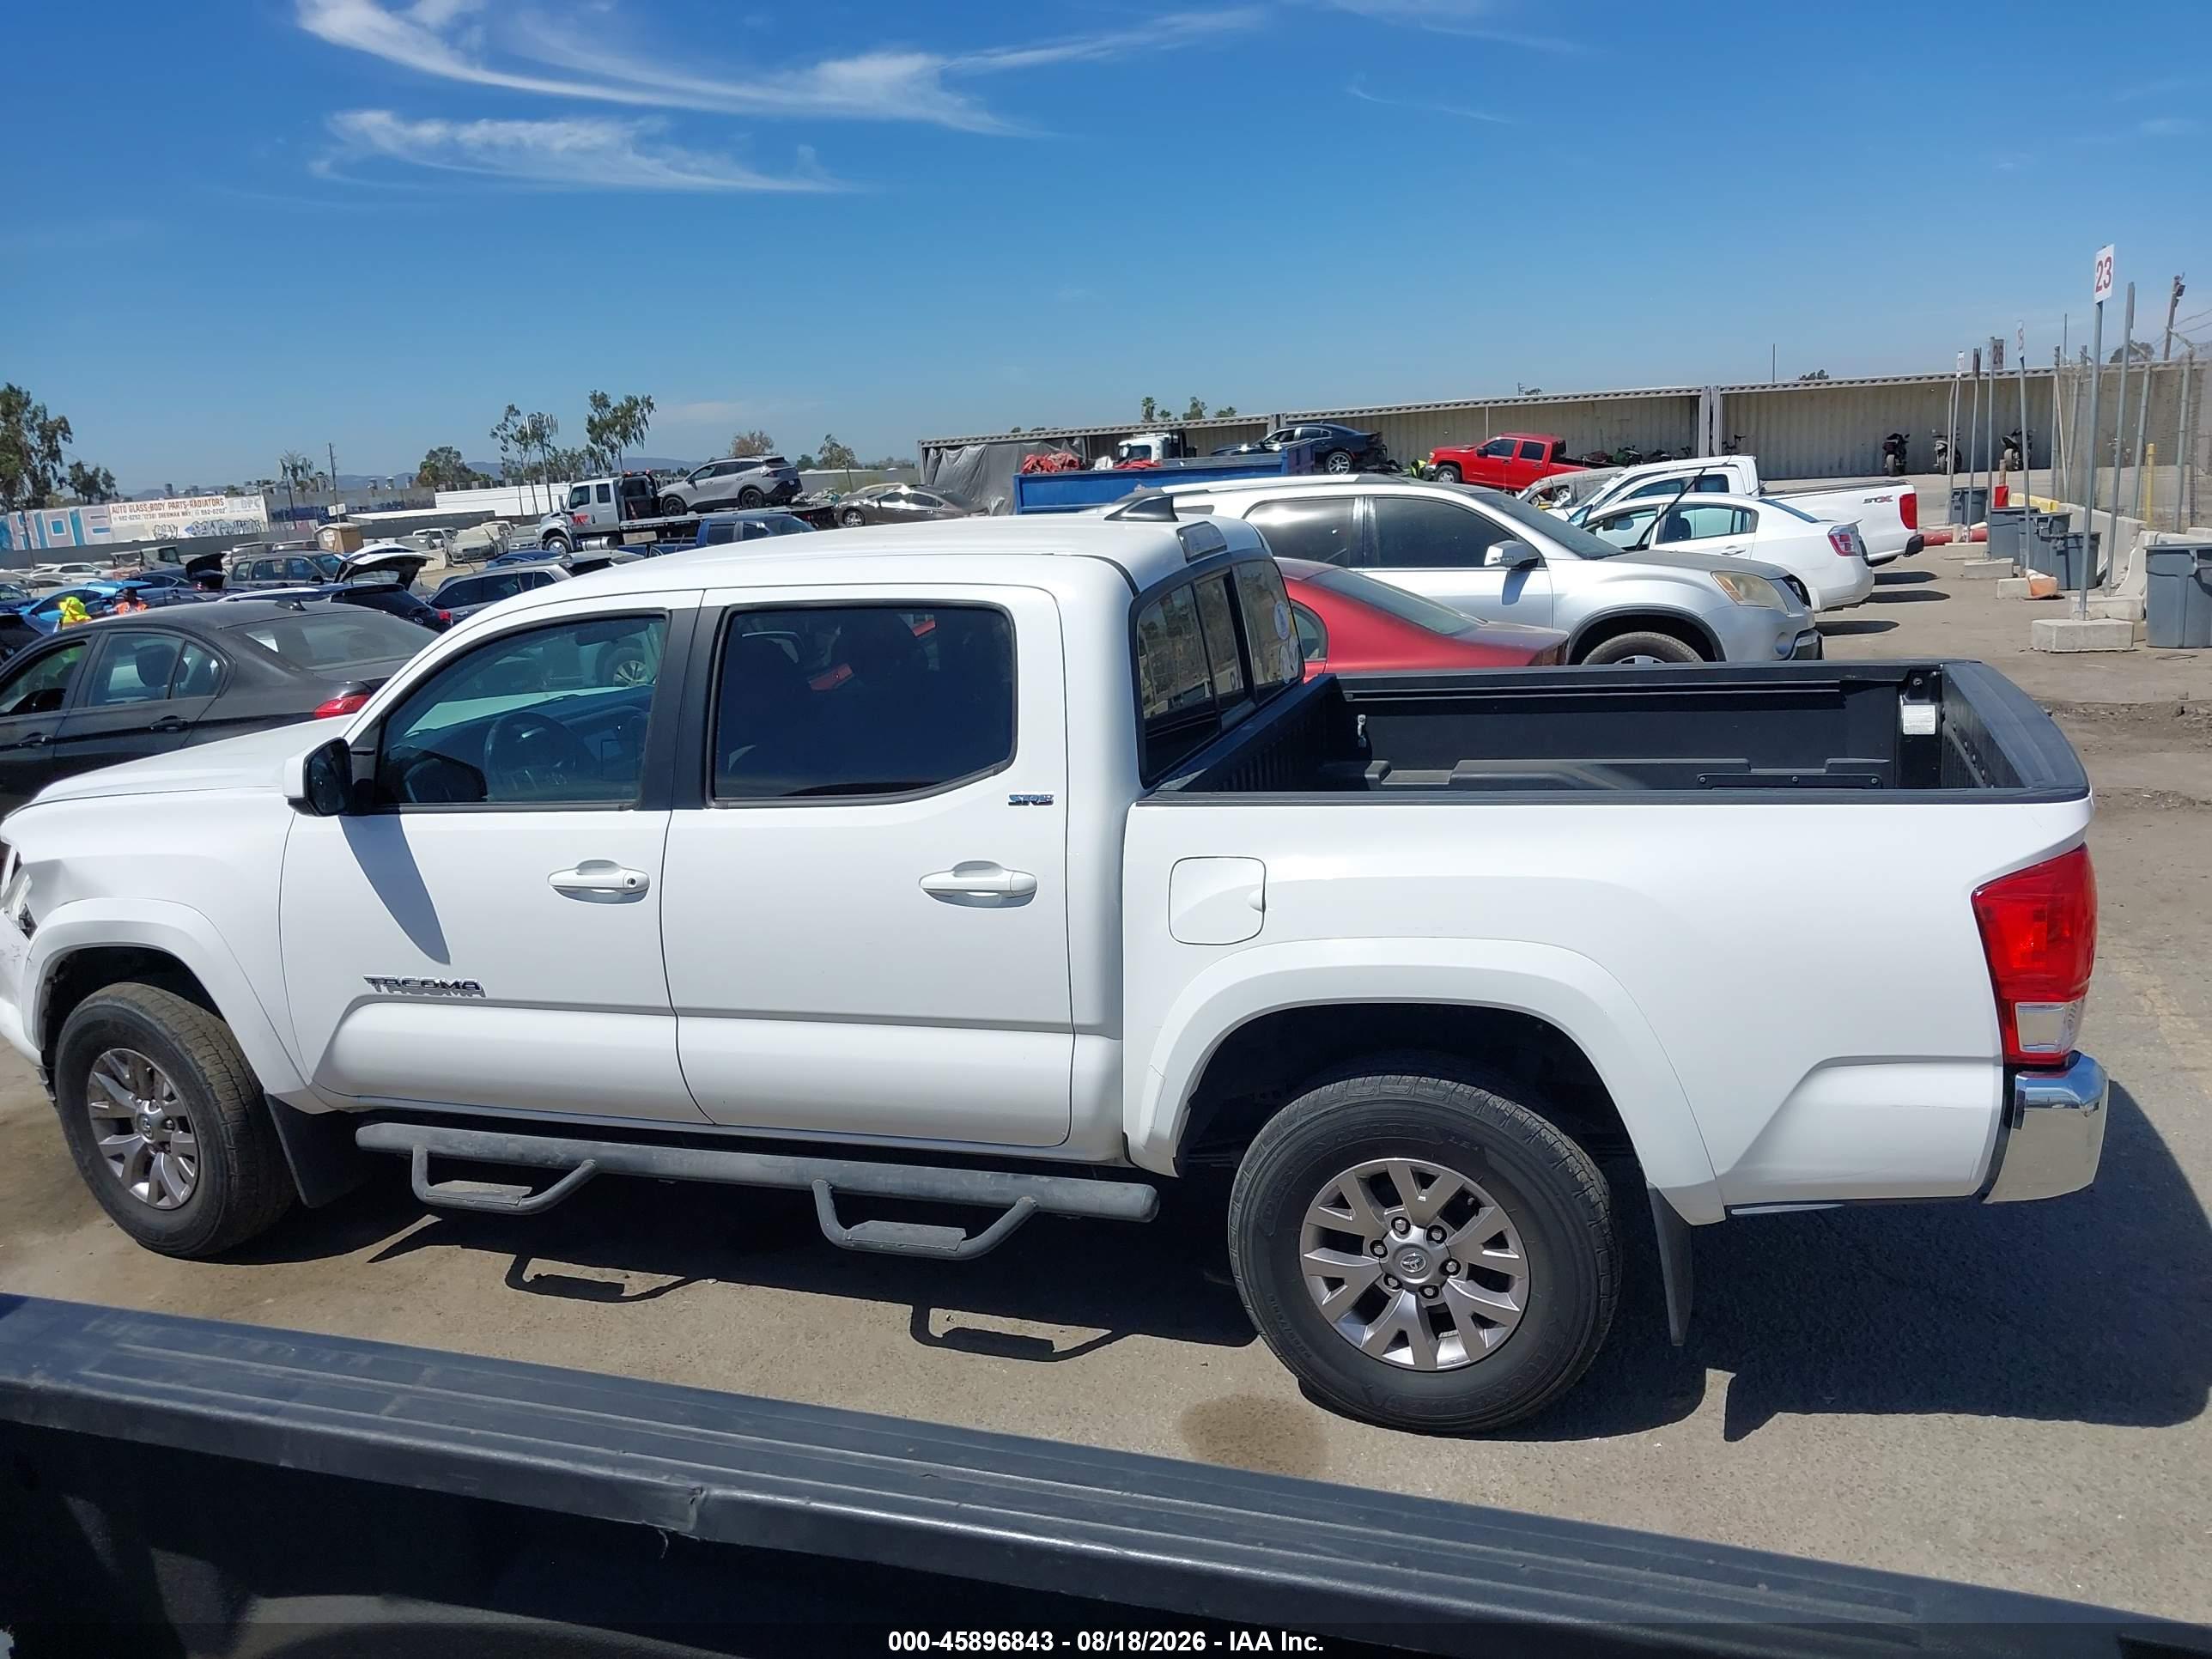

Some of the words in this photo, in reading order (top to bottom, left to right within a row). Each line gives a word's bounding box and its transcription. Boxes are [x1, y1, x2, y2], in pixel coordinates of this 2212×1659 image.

[2095, 256, 2112, 293] 23
[112, 505, 127, 514] AUTO
[363, 975, 483, 993] TACOMA
